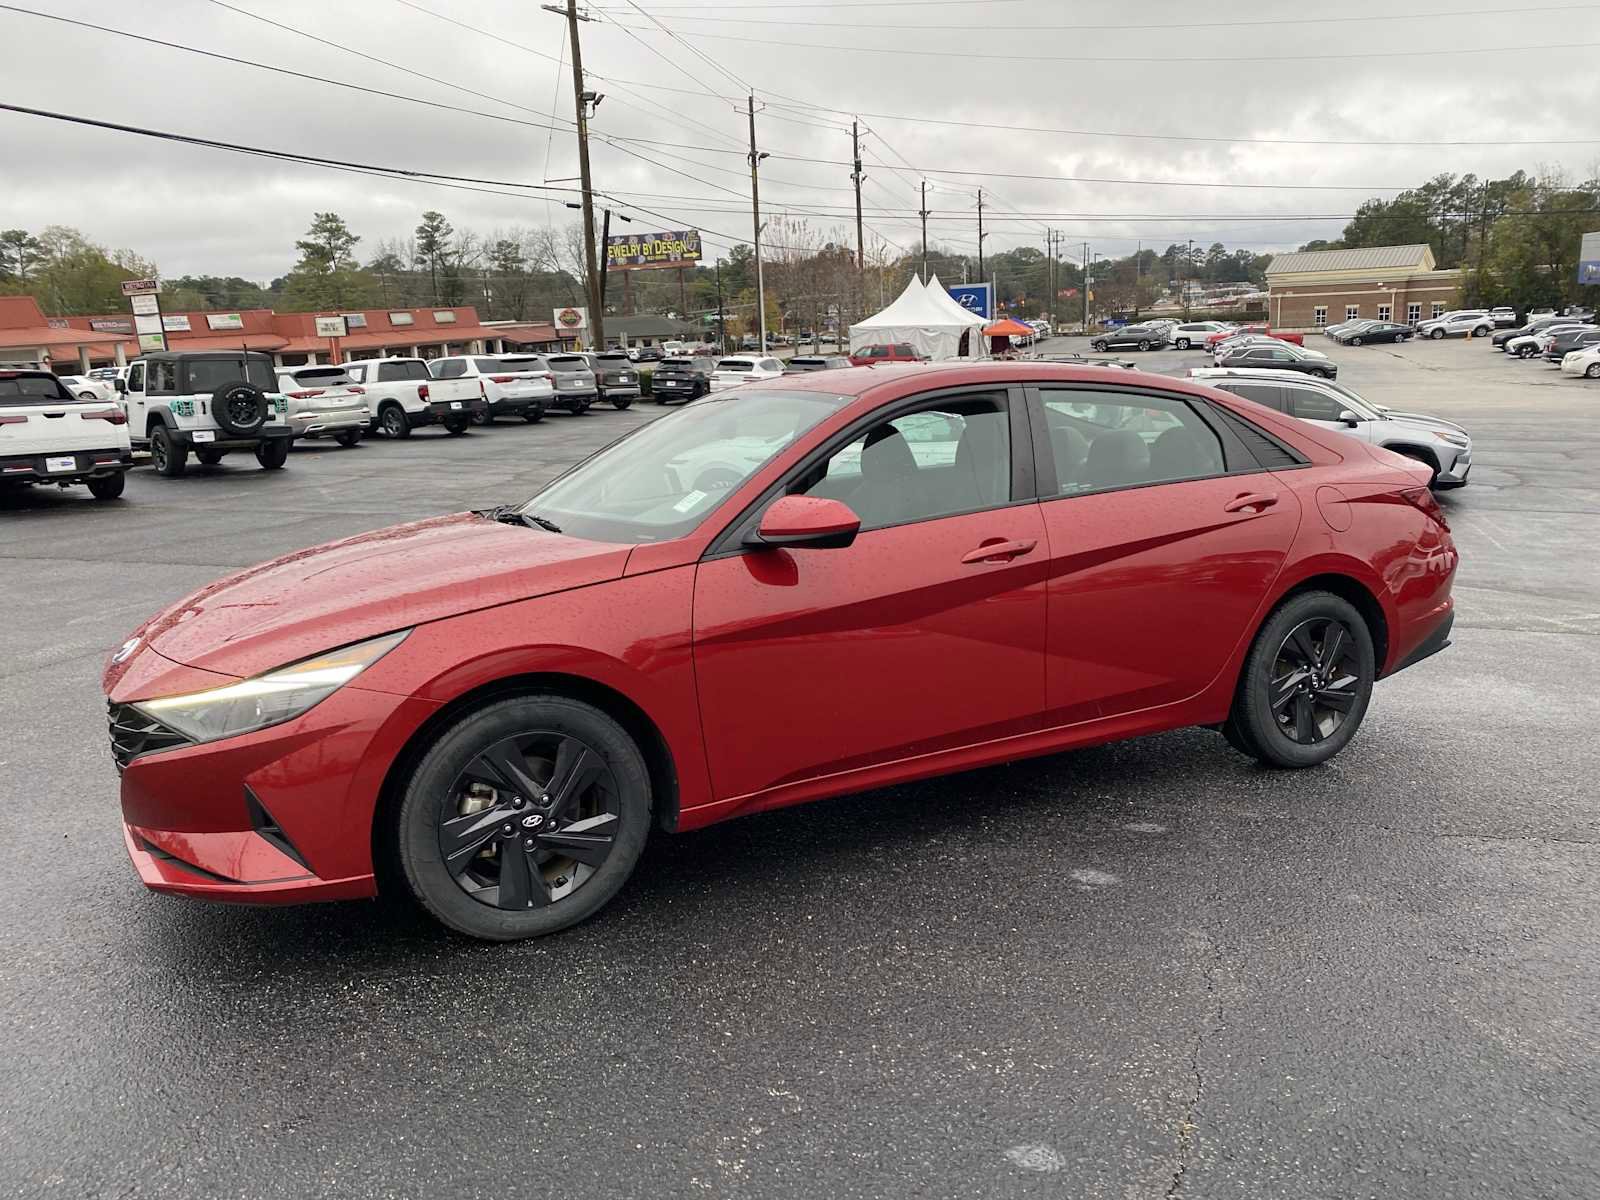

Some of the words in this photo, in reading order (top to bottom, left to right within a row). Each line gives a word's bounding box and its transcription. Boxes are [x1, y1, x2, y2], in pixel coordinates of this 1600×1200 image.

[607, 243, 641, 257] EWELRY
[643, 242, 655, 255] BY
[655, 240, 687, 254] DESIGN
